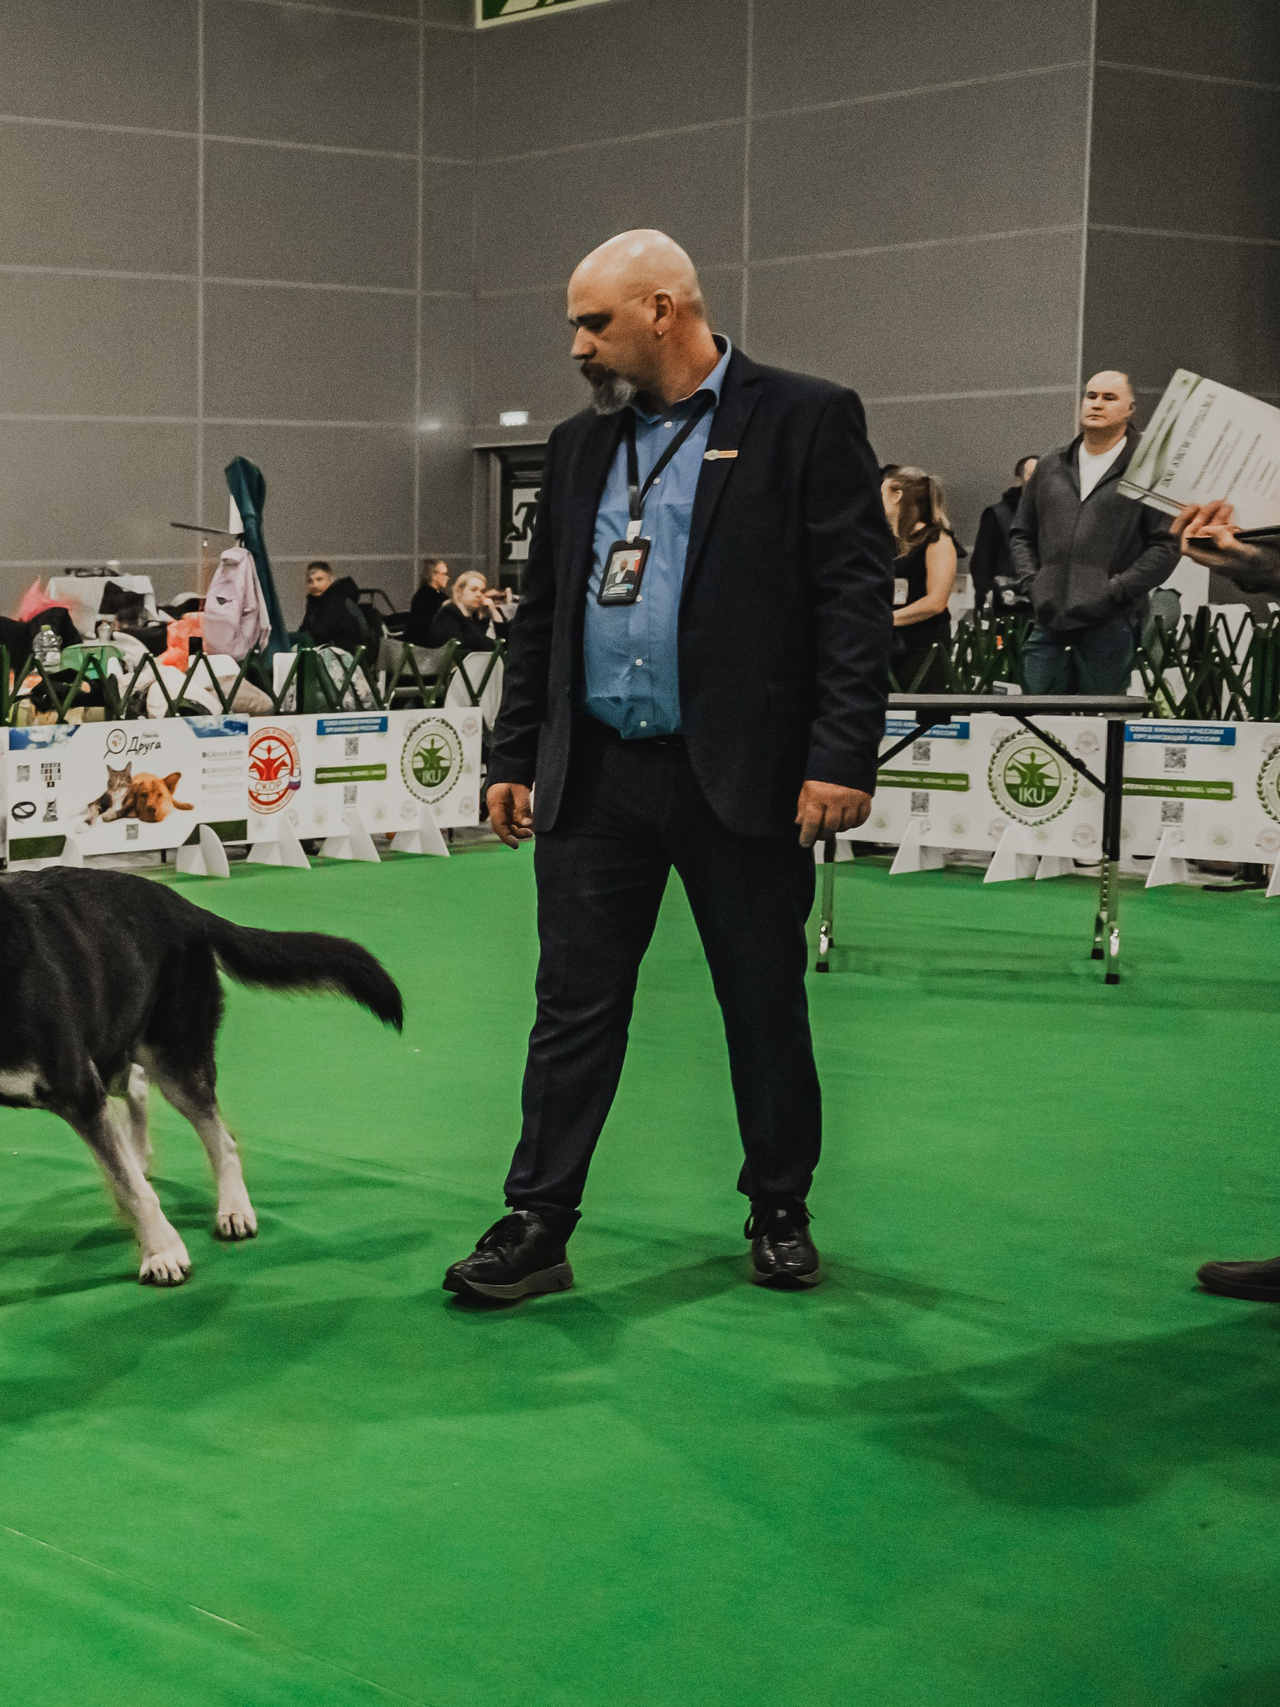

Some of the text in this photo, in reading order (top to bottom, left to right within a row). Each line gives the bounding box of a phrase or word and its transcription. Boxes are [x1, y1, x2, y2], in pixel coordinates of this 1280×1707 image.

[125, 736, 162, 756] Друга
[422, 769, 442, 784] IKU
[1018, 787, 1046, 804] IKU
